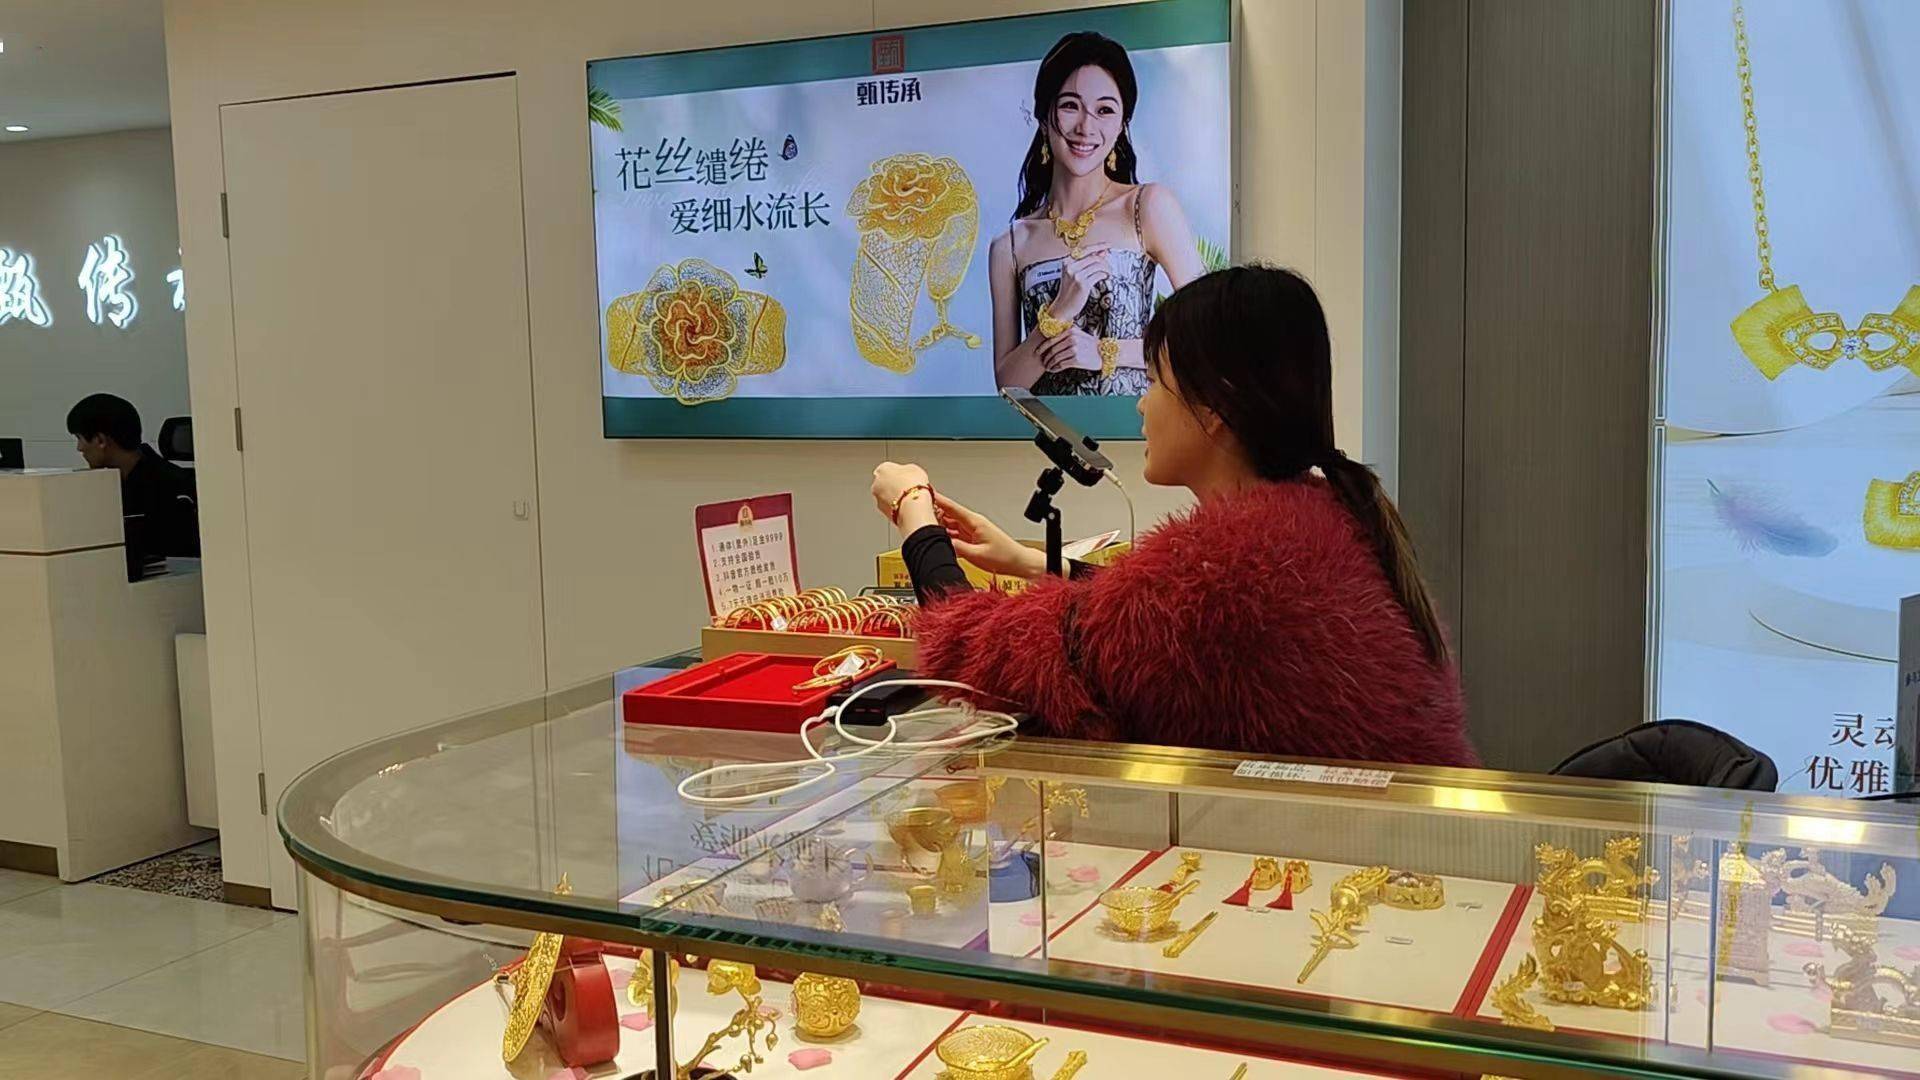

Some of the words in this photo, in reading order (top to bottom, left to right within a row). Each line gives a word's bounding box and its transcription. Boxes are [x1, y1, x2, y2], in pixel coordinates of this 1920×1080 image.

[857, 78, 921, 107] 甄传承
[615, 136, 769, 192] 花丝缱绻
[670, 191, 831, 234] 爱细水流长
[1806, 755, 1889, 794] 优雅
